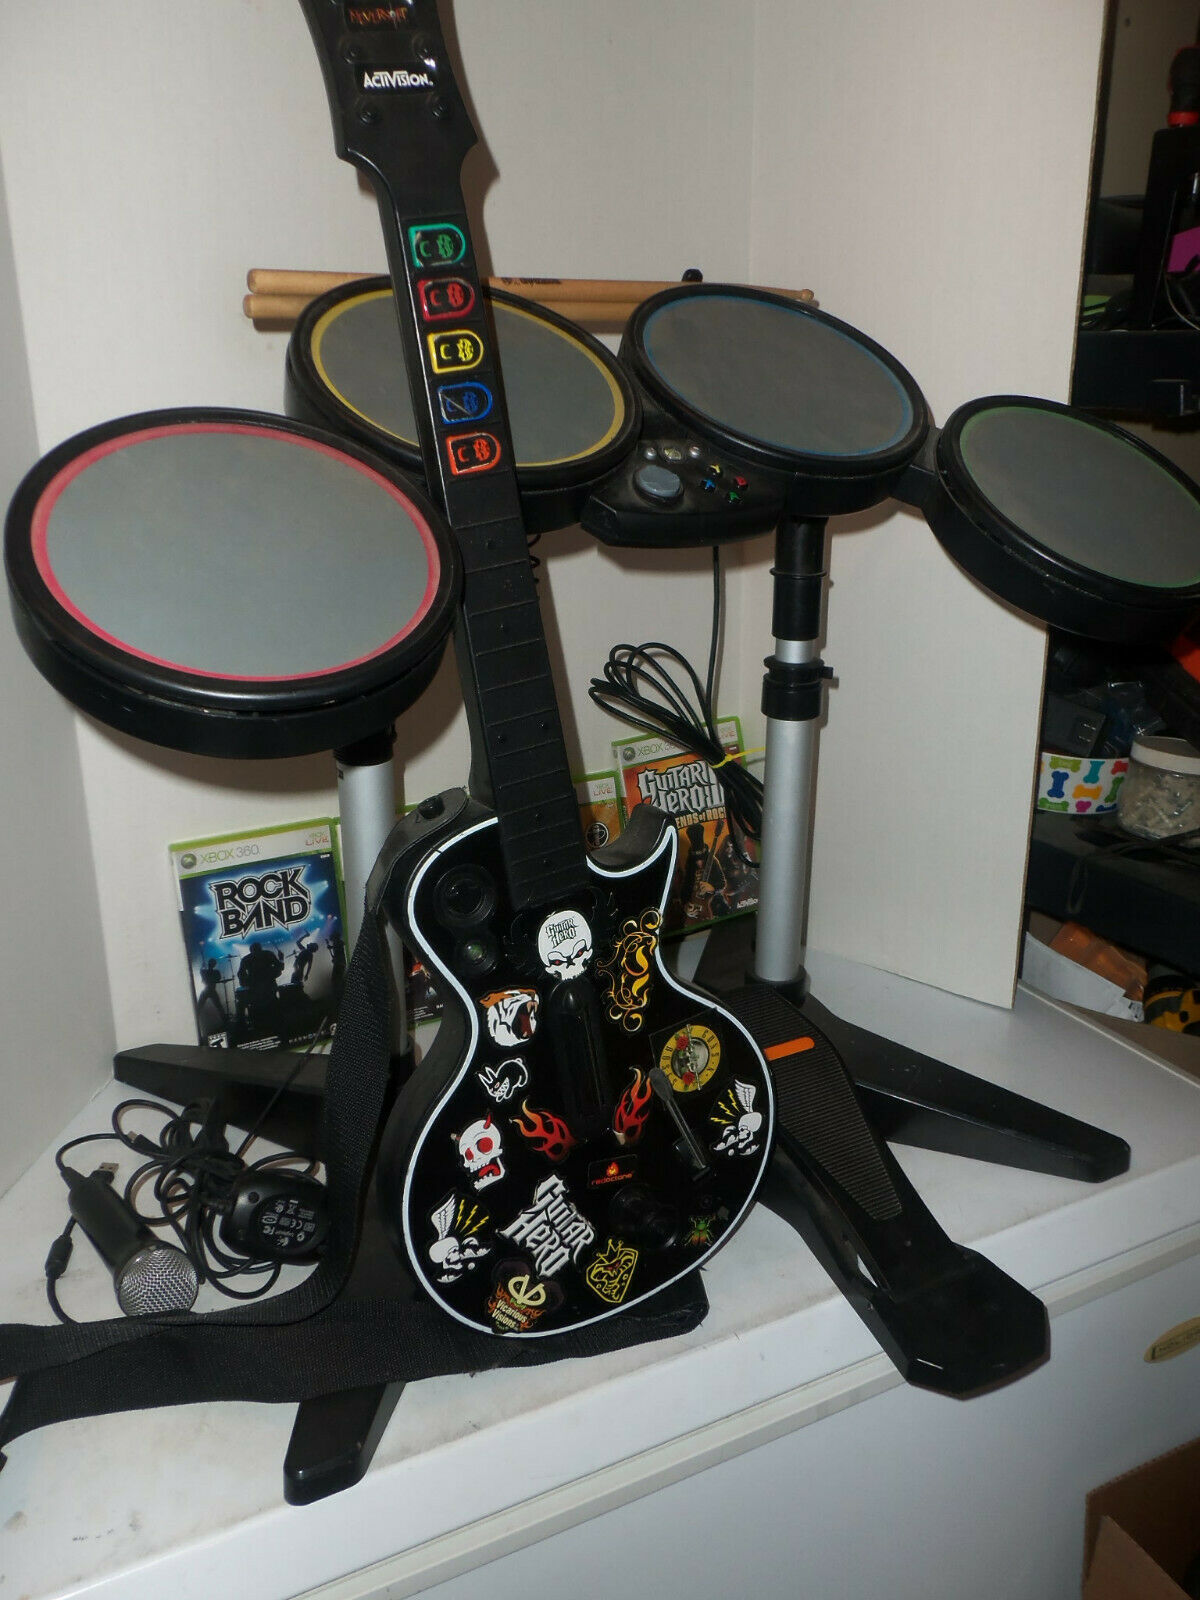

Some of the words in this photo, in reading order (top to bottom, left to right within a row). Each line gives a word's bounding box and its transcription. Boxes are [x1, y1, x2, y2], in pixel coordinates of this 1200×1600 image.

[364, 71, 429, 88] ACTIVISION
[674, 812, 699, 829] ENDS
[200, 850, 234, 864] XBOX
[236, 844, 260, 858] 360
[209, 865, 311, 912] ROCK
[216, 898, 312, 939] BAND
[591, 1172, 633, 1186] redoctane
[524, 1174, 596, 1265] GUITAR
[497, 1210, 571, 1277] HERO
[492, 1309, 517, 1328] Visions
[497, 1299, 528, 1323] Vicarious
